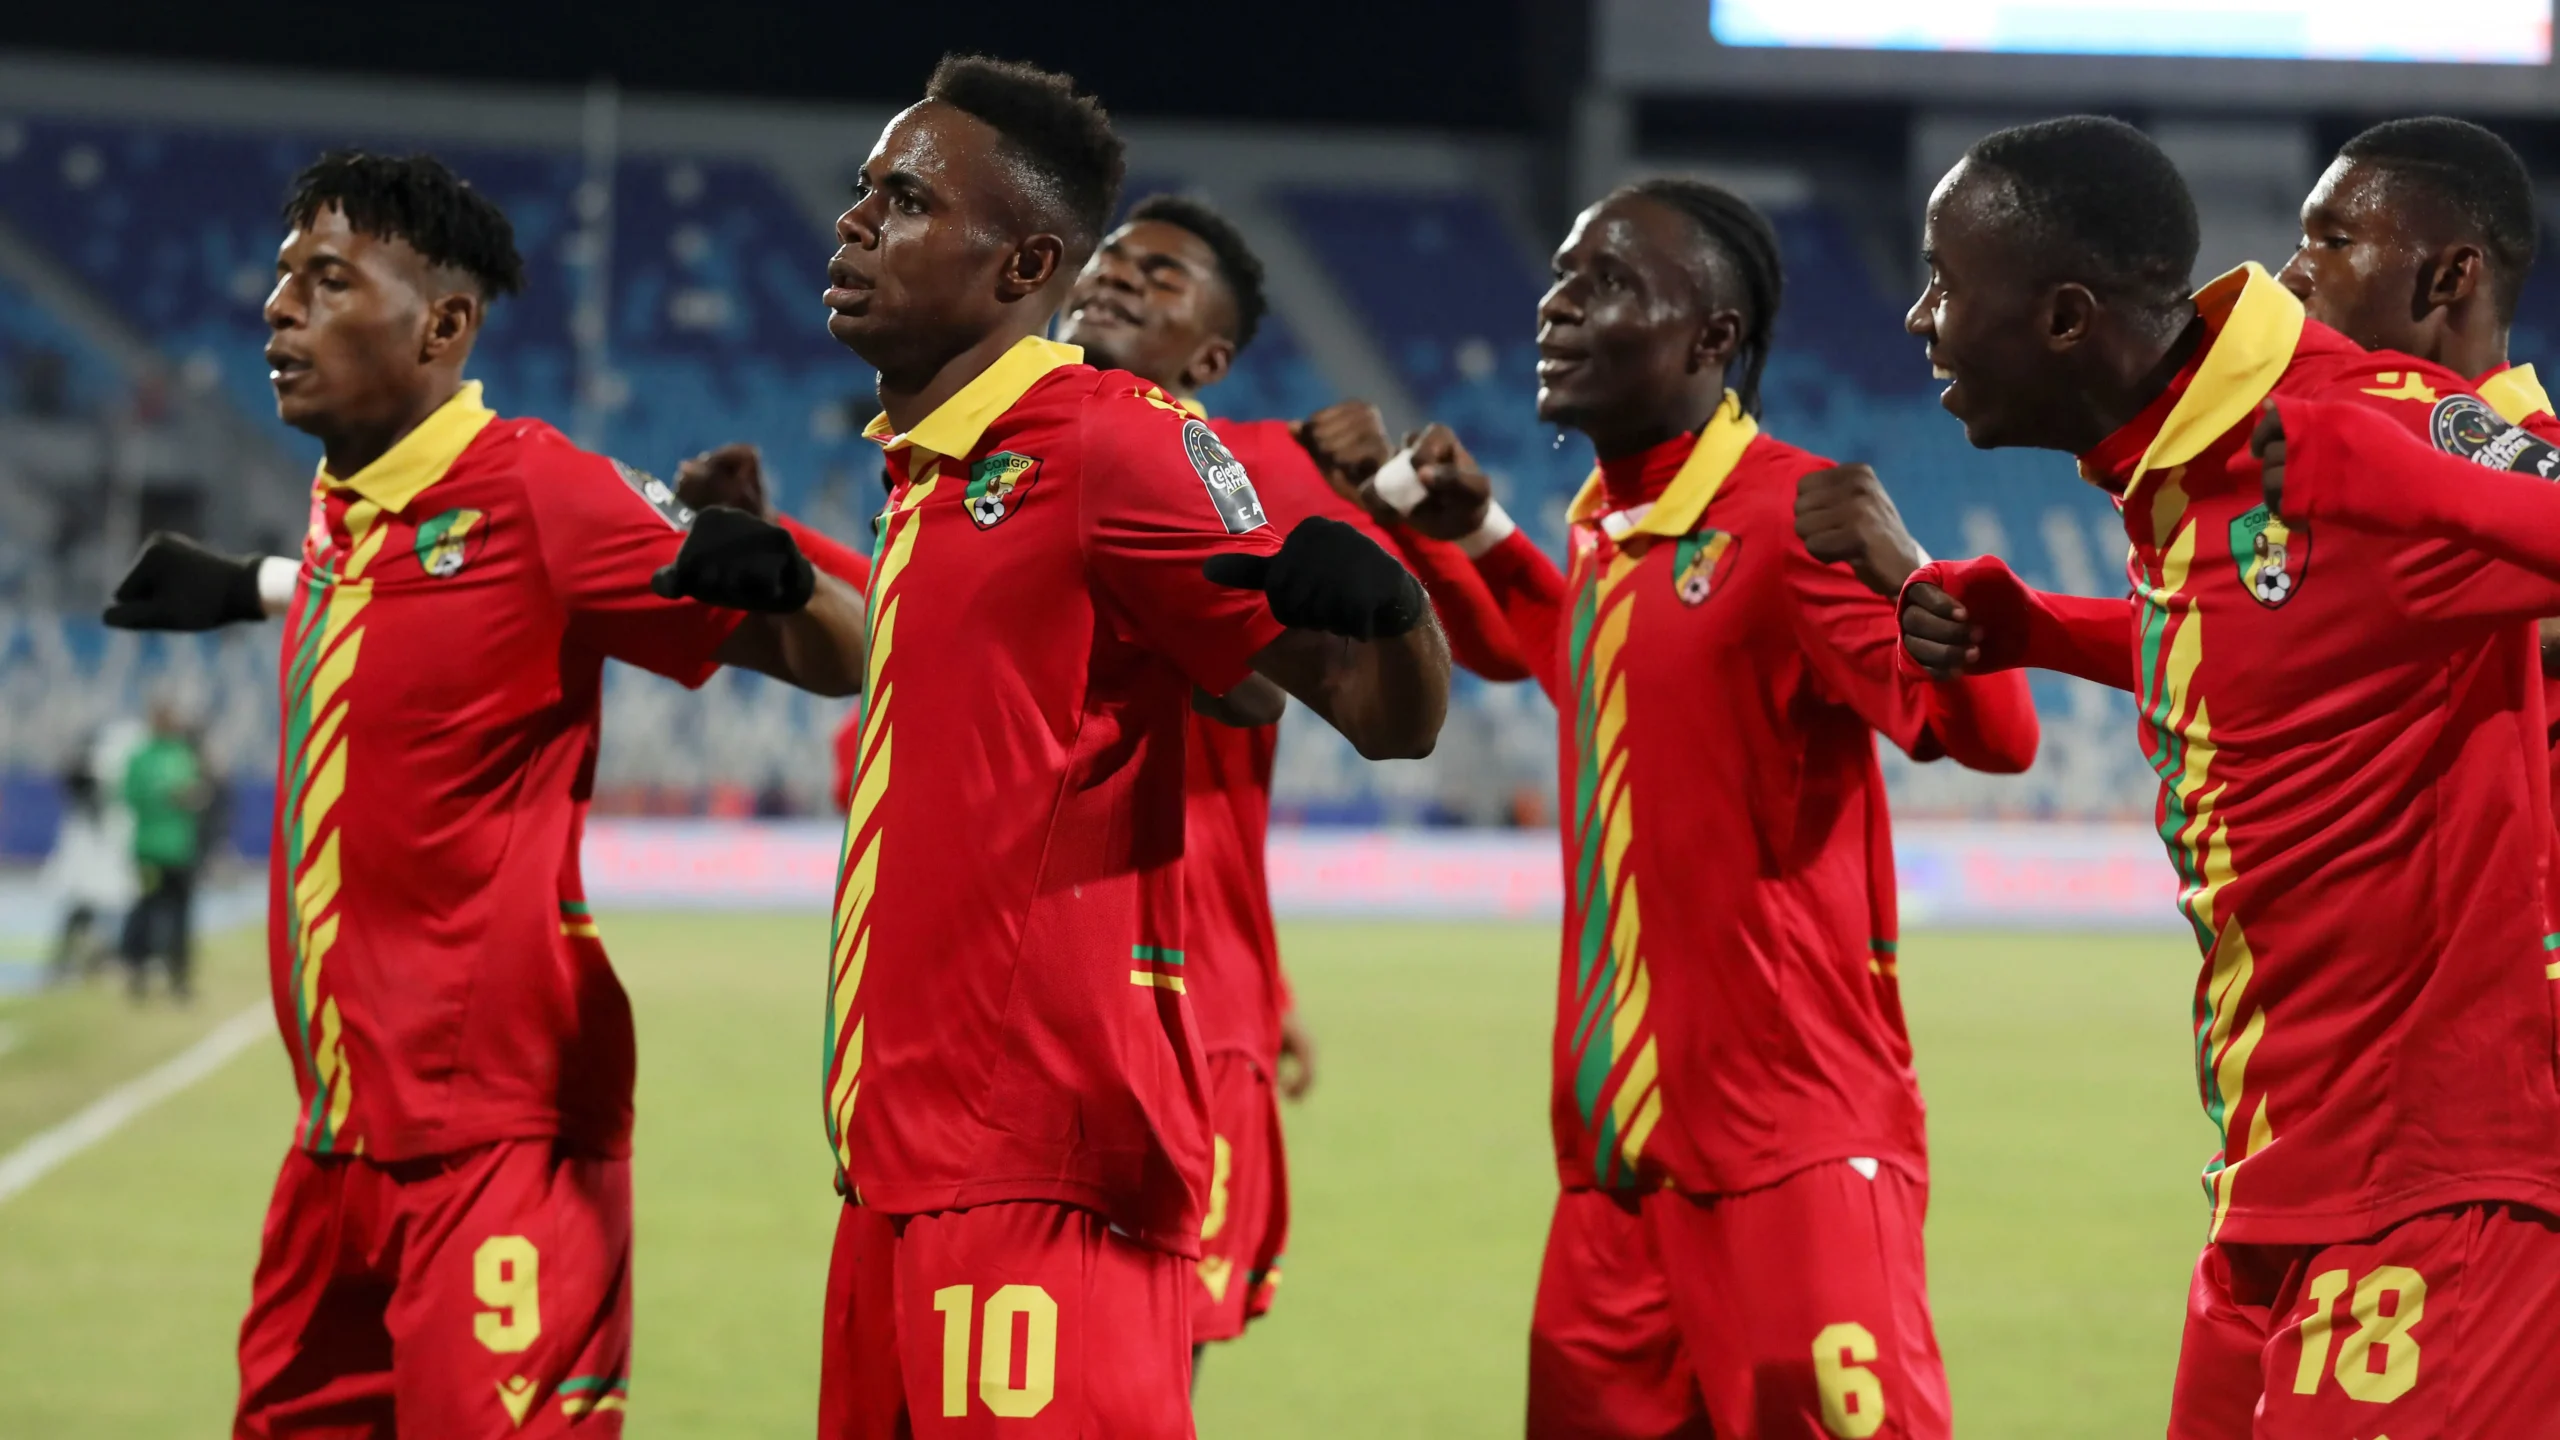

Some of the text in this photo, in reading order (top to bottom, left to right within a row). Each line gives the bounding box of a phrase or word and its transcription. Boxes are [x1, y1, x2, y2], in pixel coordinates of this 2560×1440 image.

[984, 458, 1030, 471] CONGO
[474, 1236, 541, 1353] 9
[934, 1284, 1058, 1418] 10
[2293, 1265, 2428, 1404] 18
[1811, 1322, 1886, 1440] 6
